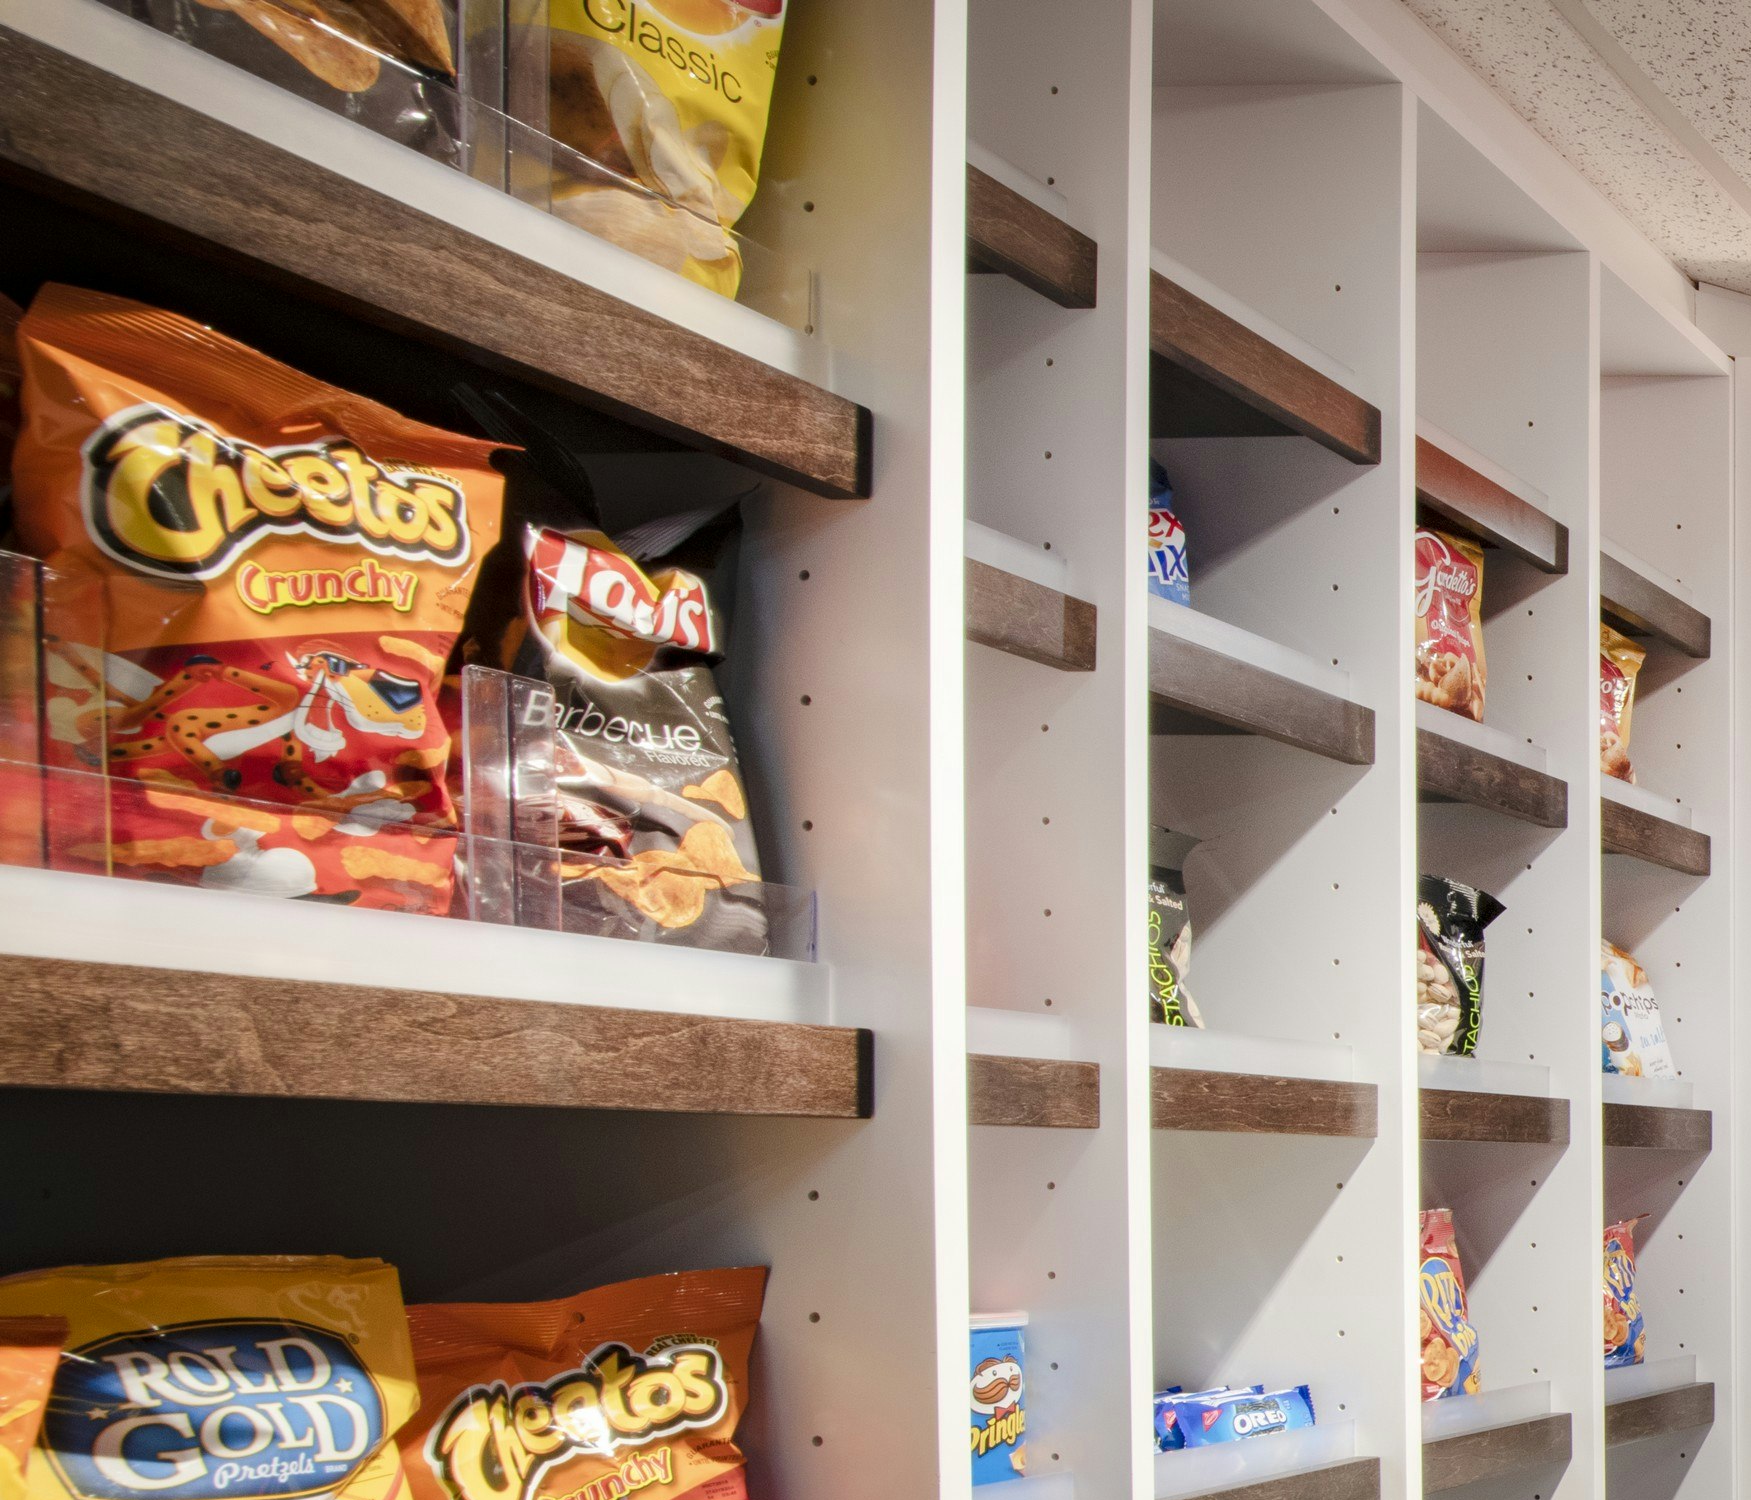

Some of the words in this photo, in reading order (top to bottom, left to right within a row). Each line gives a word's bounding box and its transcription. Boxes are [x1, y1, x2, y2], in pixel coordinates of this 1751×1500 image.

[583, 0, 742, 103] Classic
[107, 412, 464, 562] Cheetos
[240, 558, 418, 611] Crunchy
[523, 690, 701, 750] Barbecue
[648, 751, 709, 768] Flavored
[1155, 896, 1183, 910] Salted
[104, 1337, 331, 1408] ROLD
[93, 1394, 369, 1489] GOLD
[1234, 1410, 1286, 1435] OREO
[214, 1453, 315, 1489] Pretzels
